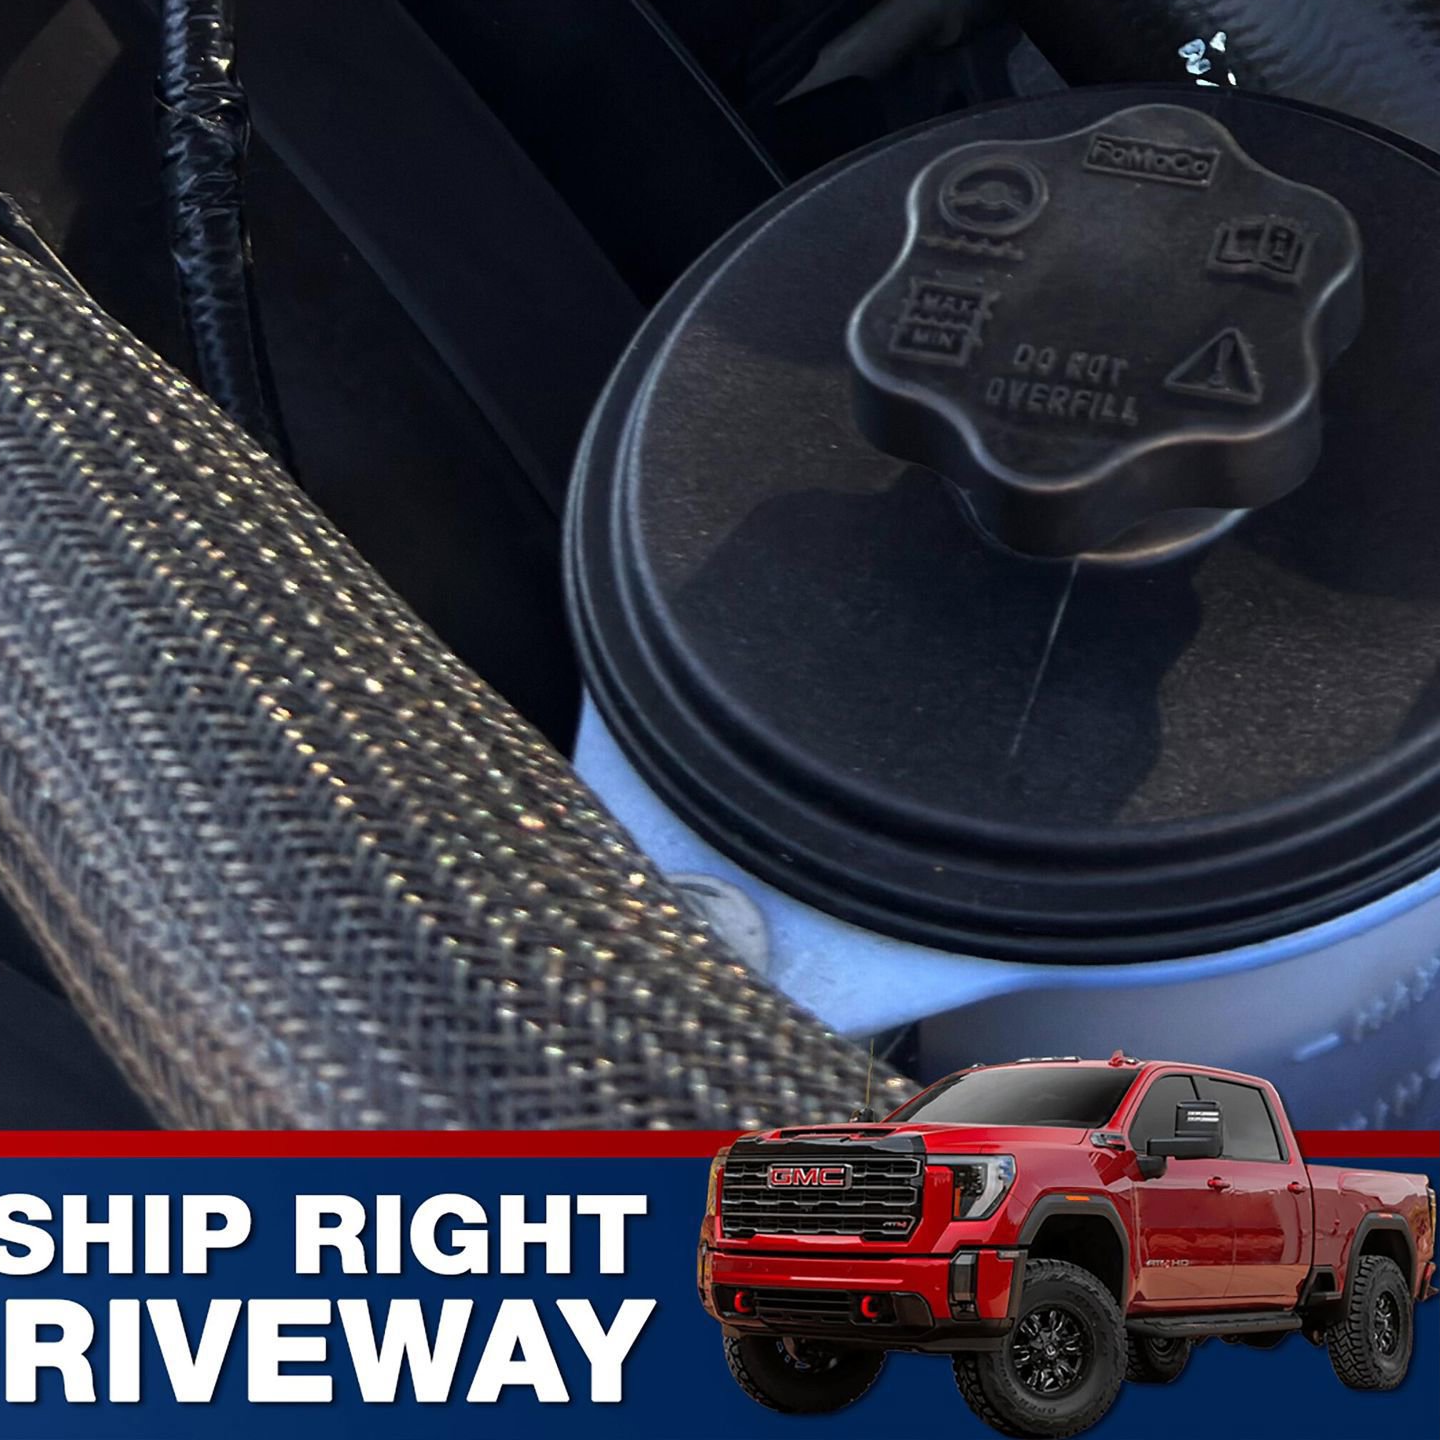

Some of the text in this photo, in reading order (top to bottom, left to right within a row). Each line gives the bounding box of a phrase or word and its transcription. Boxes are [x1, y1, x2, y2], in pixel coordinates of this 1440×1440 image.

[1013, 342, 1131, 390] DO NOT
[985, 376, 1140, 428] OVERFILL
